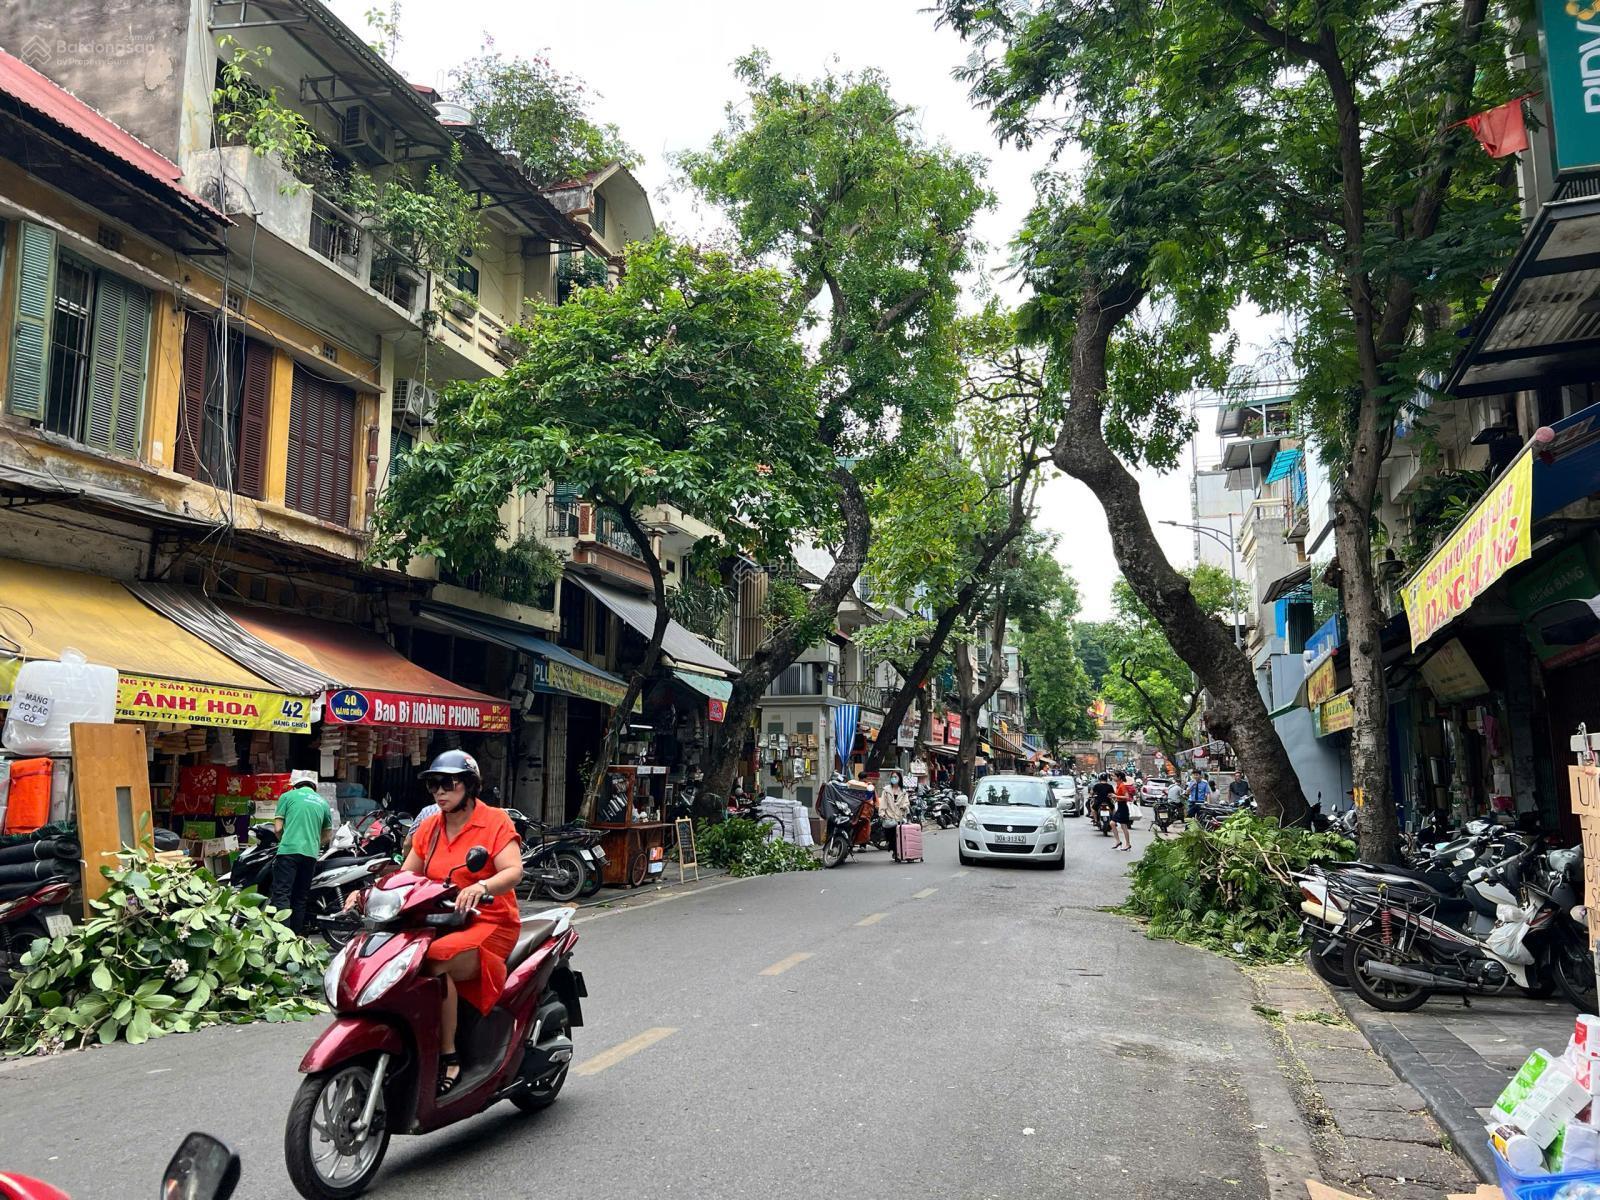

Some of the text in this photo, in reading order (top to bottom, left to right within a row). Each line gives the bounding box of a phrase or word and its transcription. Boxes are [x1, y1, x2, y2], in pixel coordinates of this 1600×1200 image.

[143, 680, 155, 688] TY
[219, 689, 240, 698] BAO
[133, 689, 197, 711] ÁNH
[207, 700, 259, 717] HOA
[282, 700, 304, 718] 42
[344, 694, 357, 706] 40
[139, 710, 158, 718] 717
[374, 699, 396, 723] Bao
[398, 700, 410, 723] Bì
[412, 699, 446, 726] HOÀNG
[448, 705, 480, 728] PHONG
